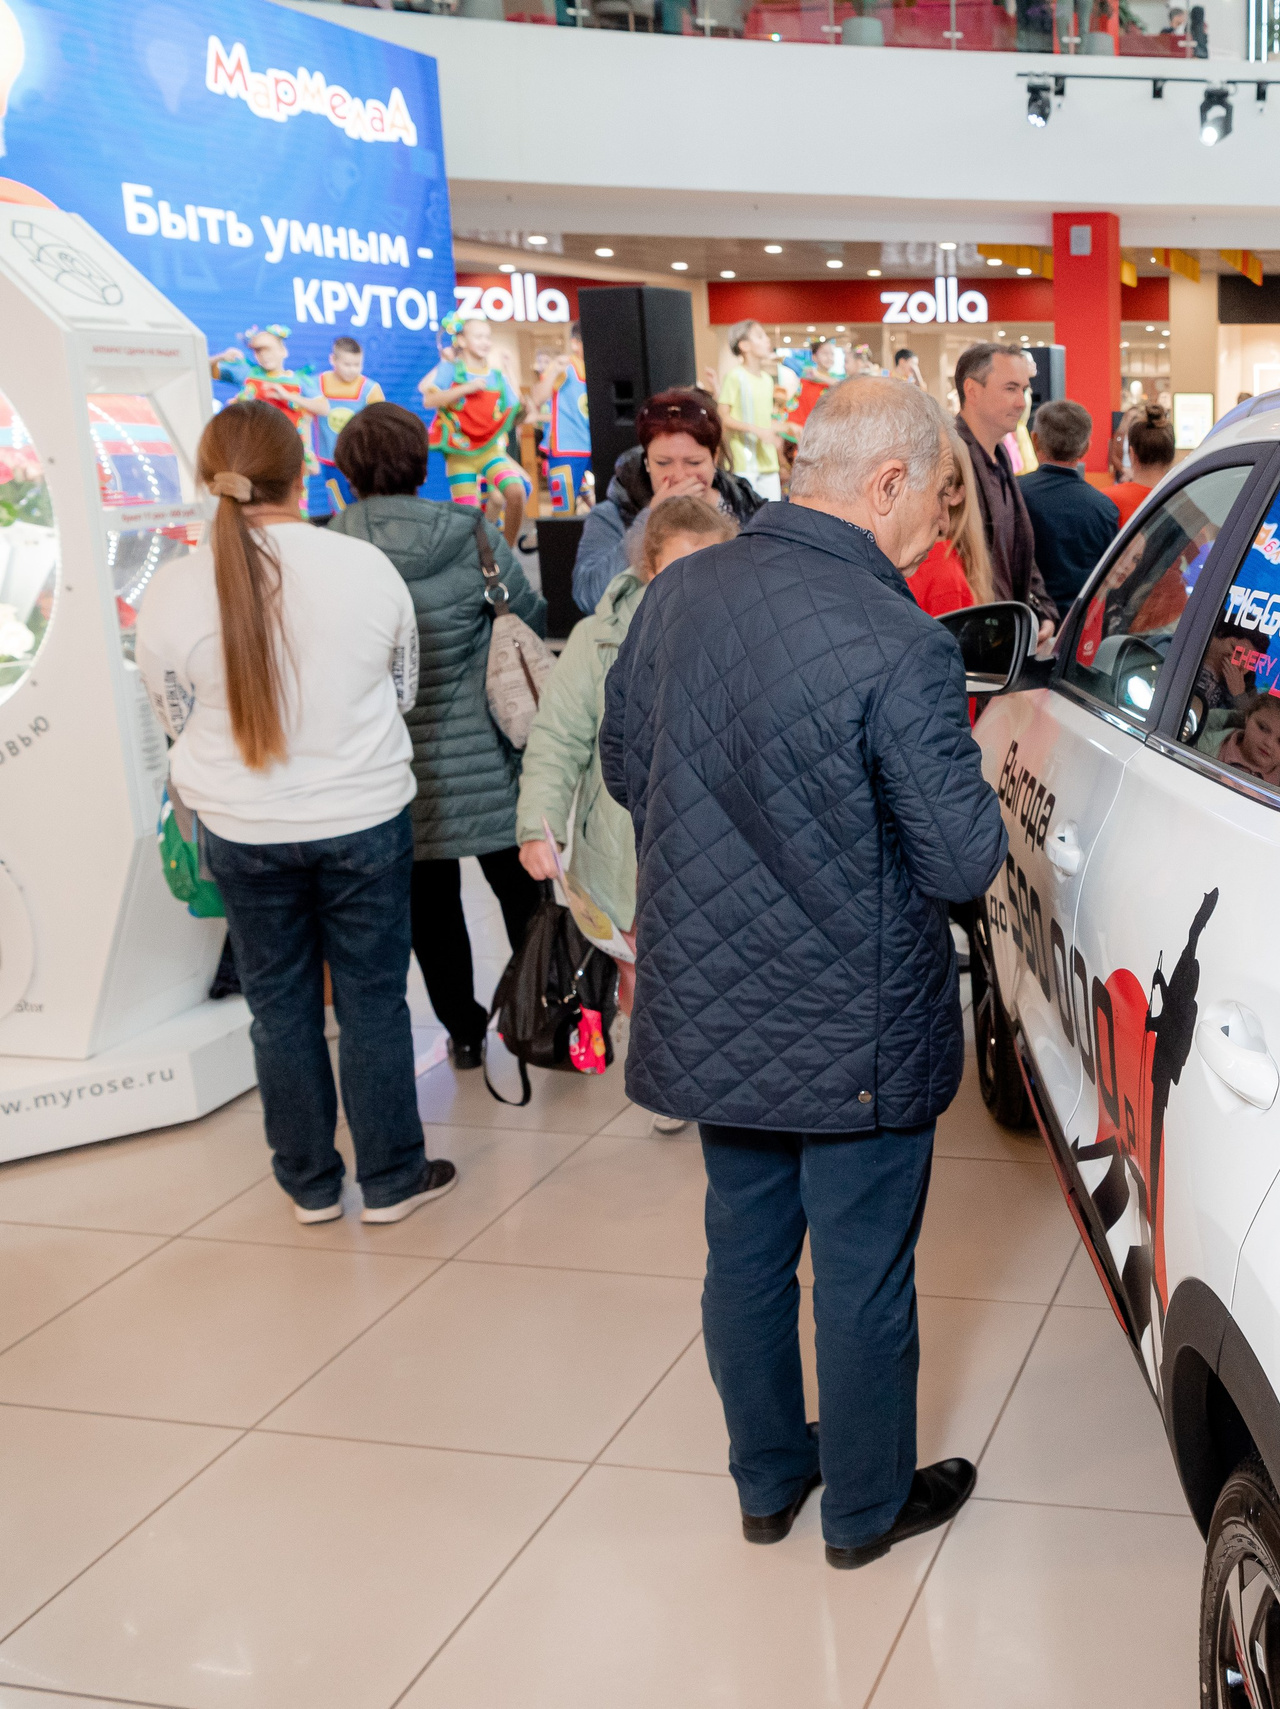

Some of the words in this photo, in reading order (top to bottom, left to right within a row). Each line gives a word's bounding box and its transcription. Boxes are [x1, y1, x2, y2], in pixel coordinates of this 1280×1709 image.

[121, 182, 254, 248] Быть
[260, 215, 410, 268] умным
[293, 277, 439, 332] КРУТО!
[453, 273, 570, 323] zolla
[880, 276, 988, 323] zolla
[1231, 646, 1278, 676] CHERY
[998, 740, 1056, 853] Выгода
[989, 894, 1008, 934] до
